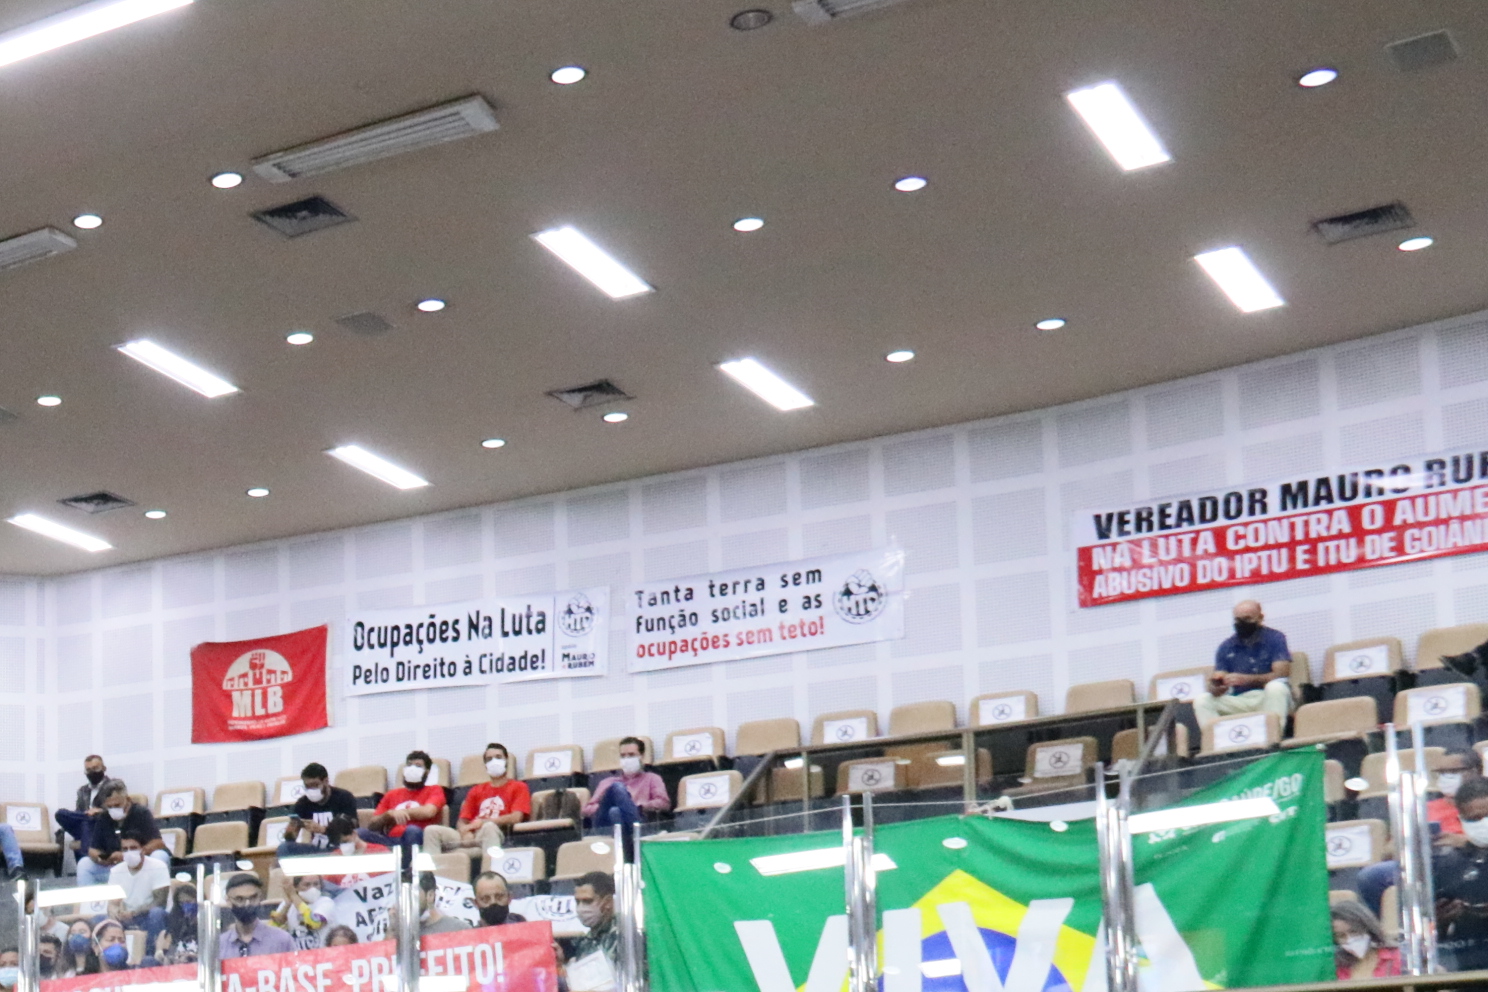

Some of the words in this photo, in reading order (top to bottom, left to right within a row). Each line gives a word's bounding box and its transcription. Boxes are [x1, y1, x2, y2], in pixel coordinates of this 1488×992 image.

[1093, 487, 1268, 540] VEREADOR
[1091, 541, 1133, 570] NA
[1141, 530, 1216, 564] LUTA
[1225, 509, 1352, 551] CONTRA
[1361, 504, 1384, 530] O
[1092, 562, 1191, 599] ABUSIVO
[1196, 556, 1229, 584] DO
[1234, 548, 1289, 579] IPTU
[1295, 544, 1311, 570] E
[1317, 537, 1359, 567] ITU
[1364, 531, 1398, 560] DE
[634, 585, 694, 608] Tanta
[709, 576, 766, 598] terra
[780, 568, 823, 589] sem
[353, 614, 460, 658] Ocupações
[467, 610, 493, 641] Na
[500, 604, 546, 638] Luta
[636, 608, 699, 635] função
[711, 598, 765, 624] social
[778, 598, 788, 614] e
[802, 592, 823, 611] as
[636, 631, 731, 661] ocupações
[735, 627, 773, 647] sem
[779, 616, 825, 641] teto!
[352, 662, 390, 686] Pelo
[396, 656, 457, 683] Direito
[462, 659, 473, 677] à
[478, 649, 546, 675] Cidade!
[232, 686, 284, 717] MLB
